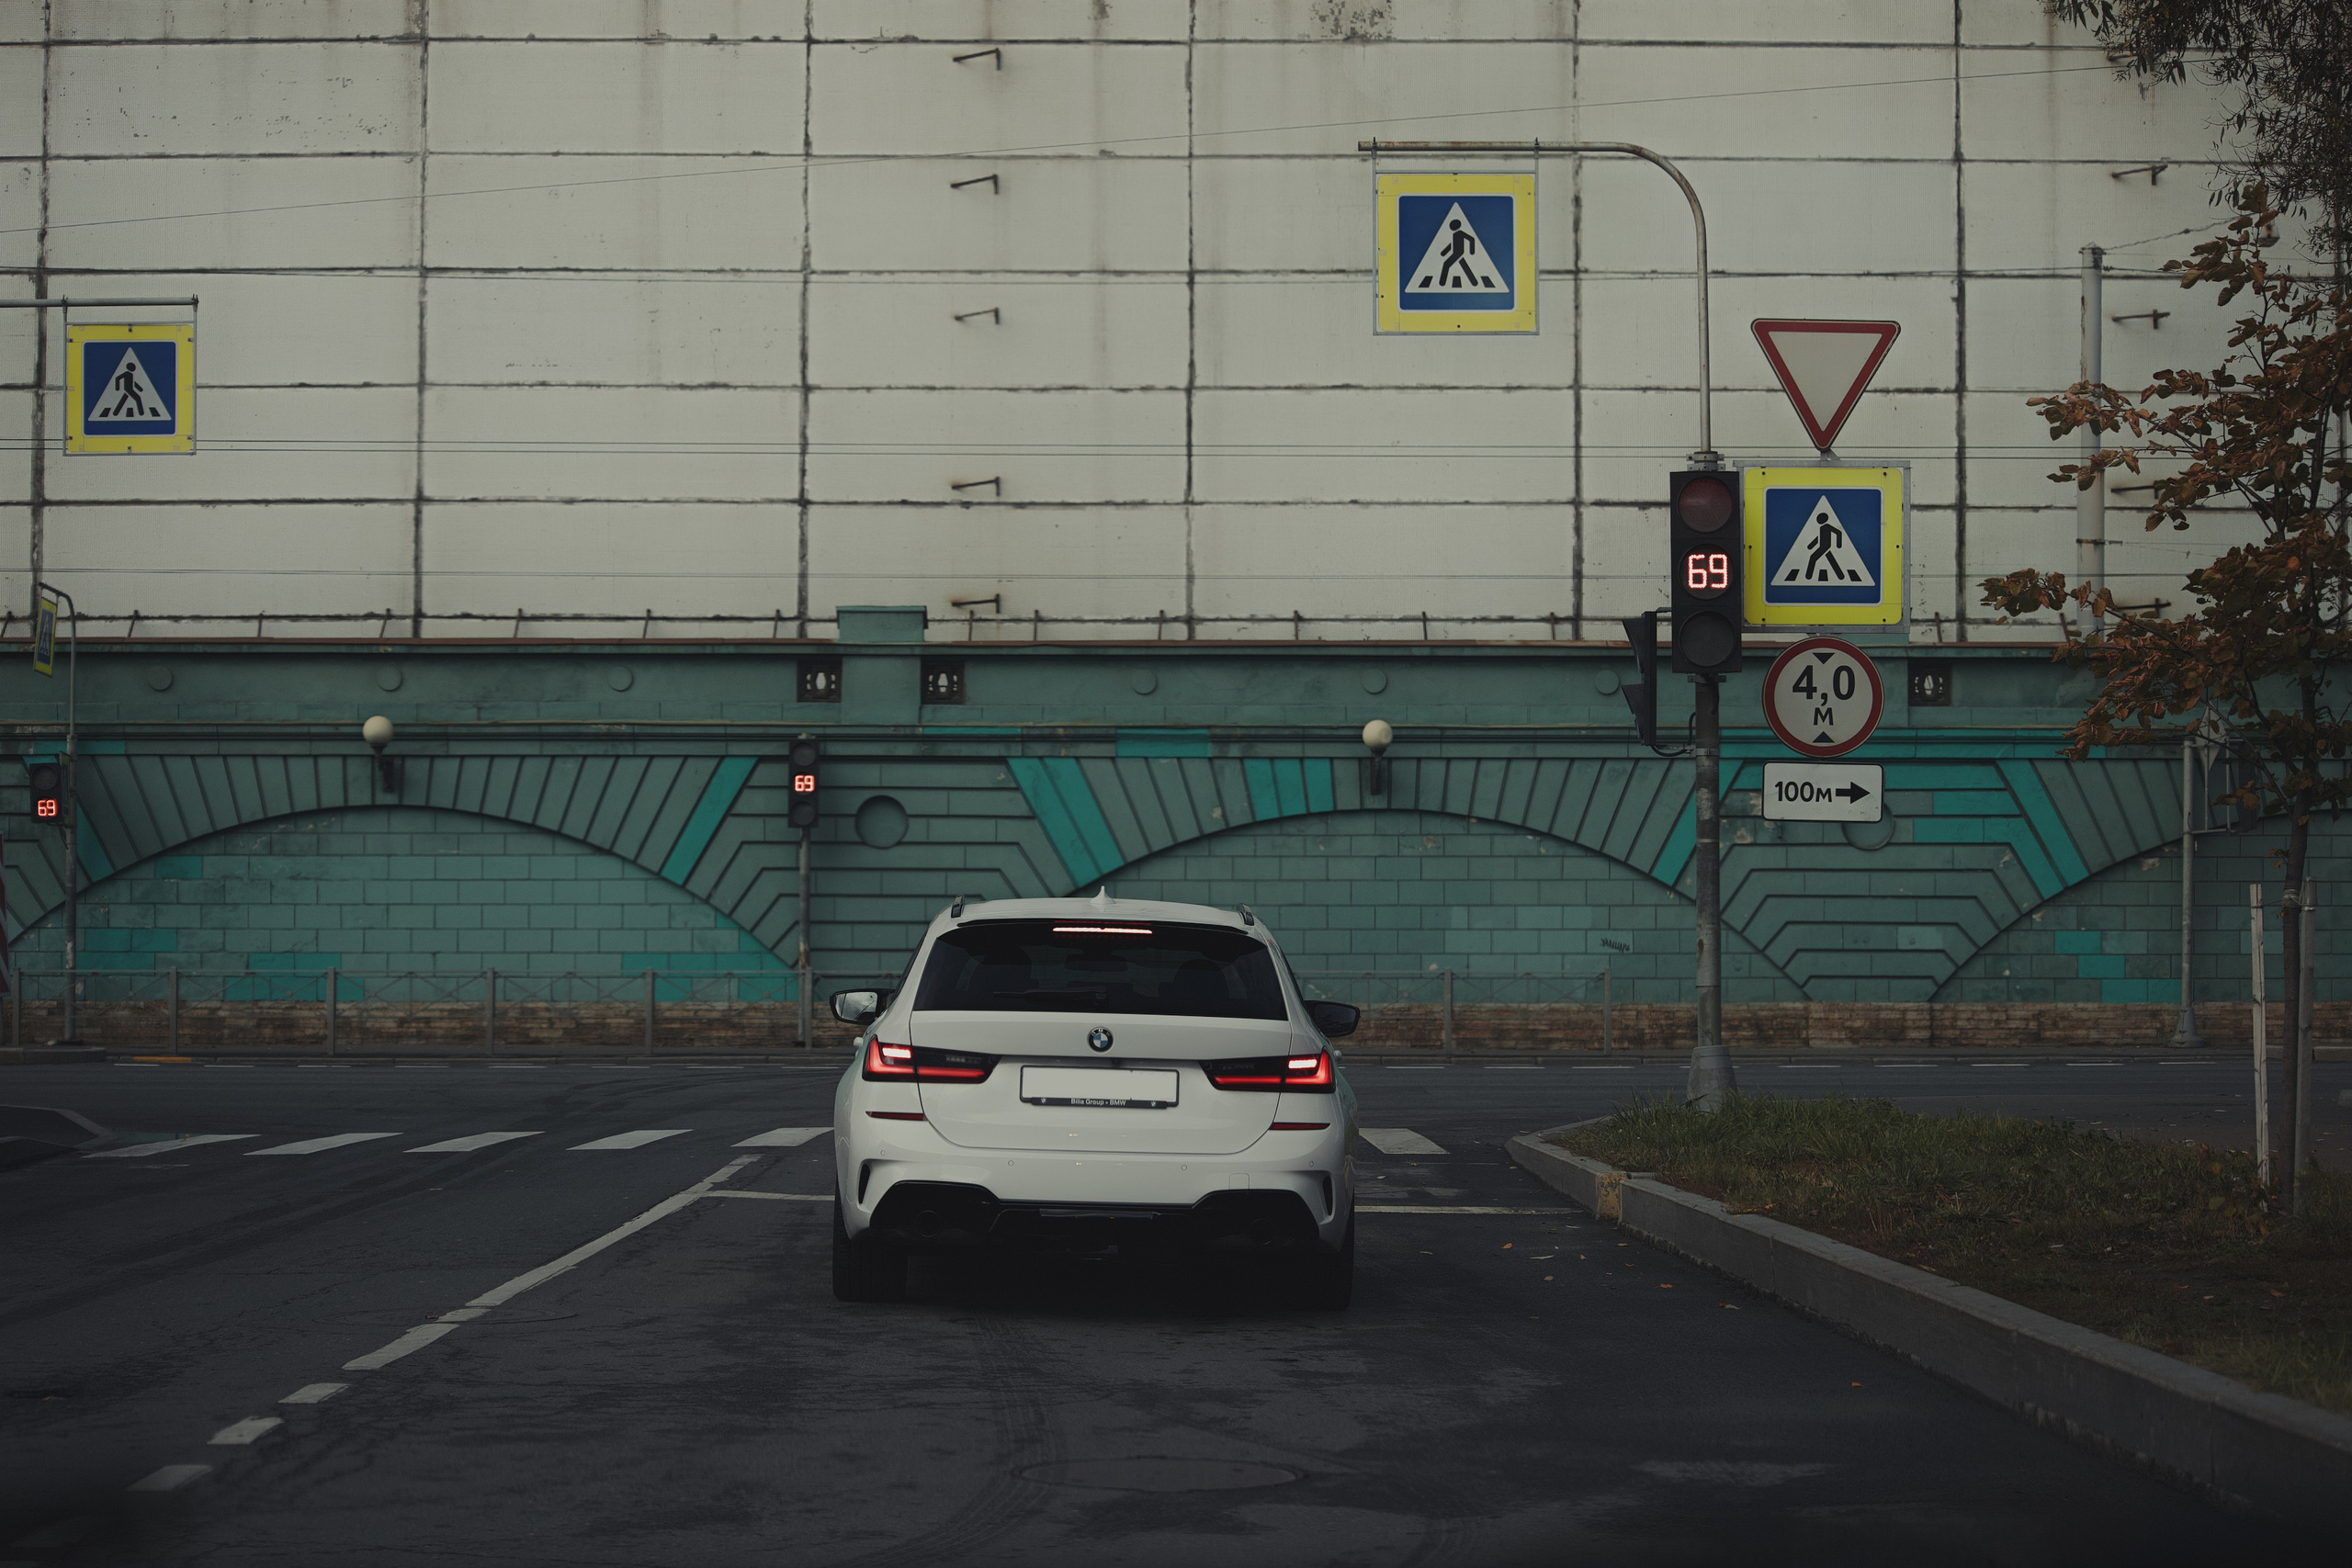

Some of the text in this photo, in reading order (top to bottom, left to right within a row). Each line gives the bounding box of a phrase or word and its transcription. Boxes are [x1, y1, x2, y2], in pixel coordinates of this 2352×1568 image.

[1688, 554, 1728, 589] 69
[1792, 665, 1856, 706] 4,0
[795, 774, 815, 792] 69
[38, 799, 57, 817] 69
[1085, 1099, 1104, 1107] Group
